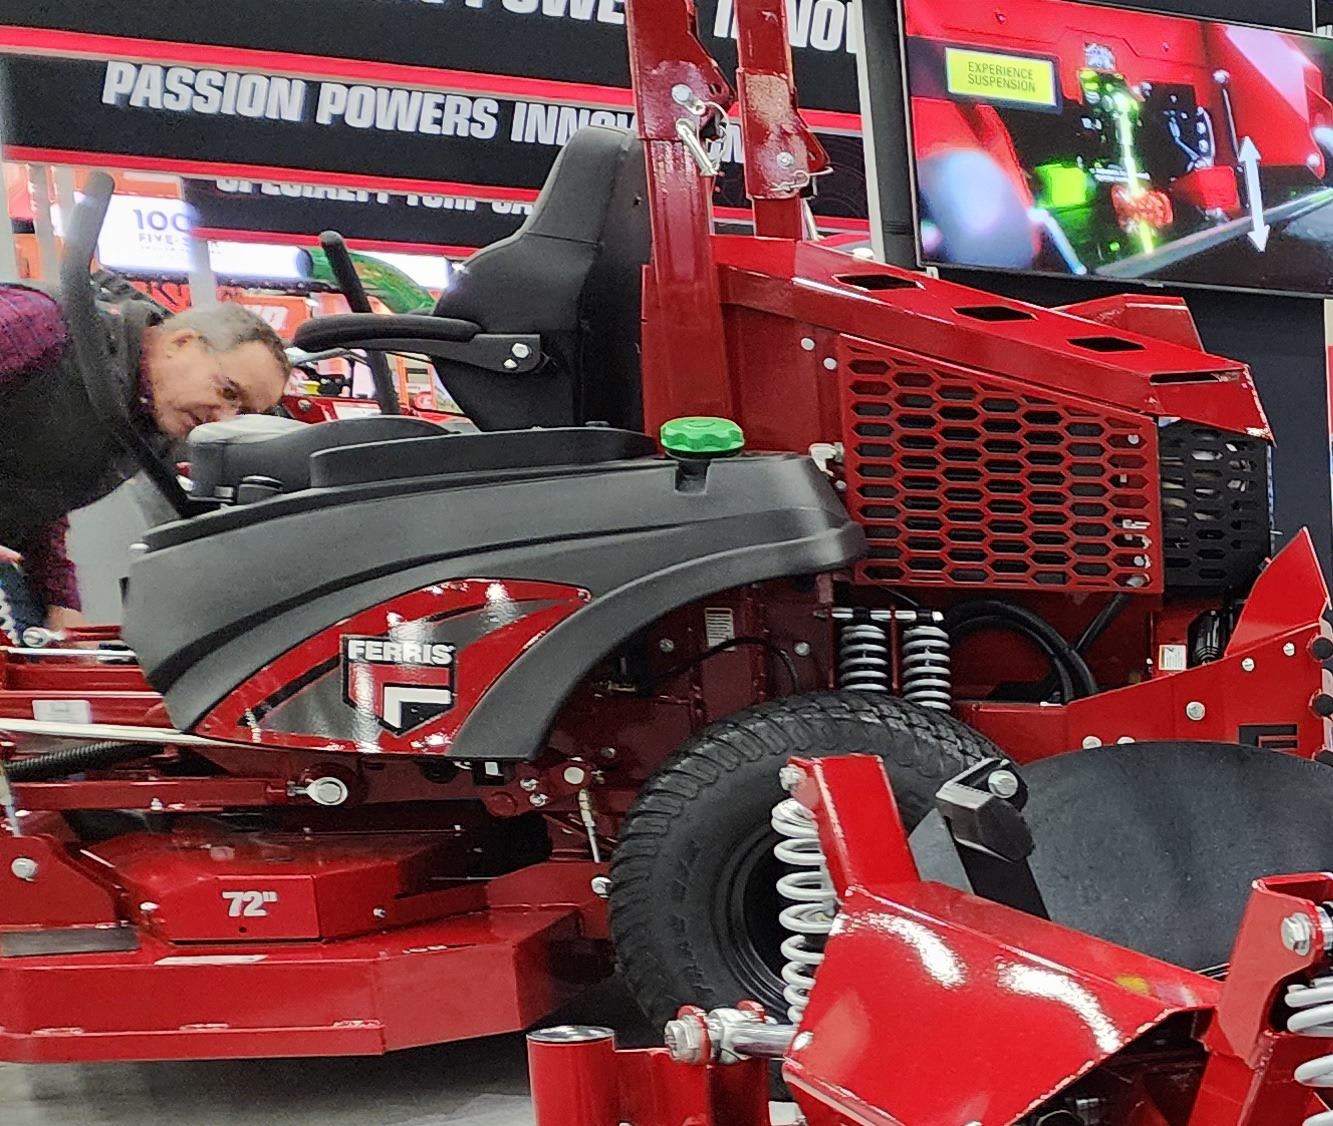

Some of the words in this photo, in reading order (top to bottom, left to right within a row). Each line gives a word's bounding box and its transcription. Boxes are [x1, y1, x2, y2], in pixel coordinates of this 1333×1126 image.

[967, 73, 1036, 93] SUSPENSION
[968, 61, 1034, 80] EXPERIENCE
[102, 60, 305, 123] PASSION
[316, 82, 498, 140] POWERS
[348, 640, 453, 665] FERRIS
[222, 890, 278, 918] 72"
